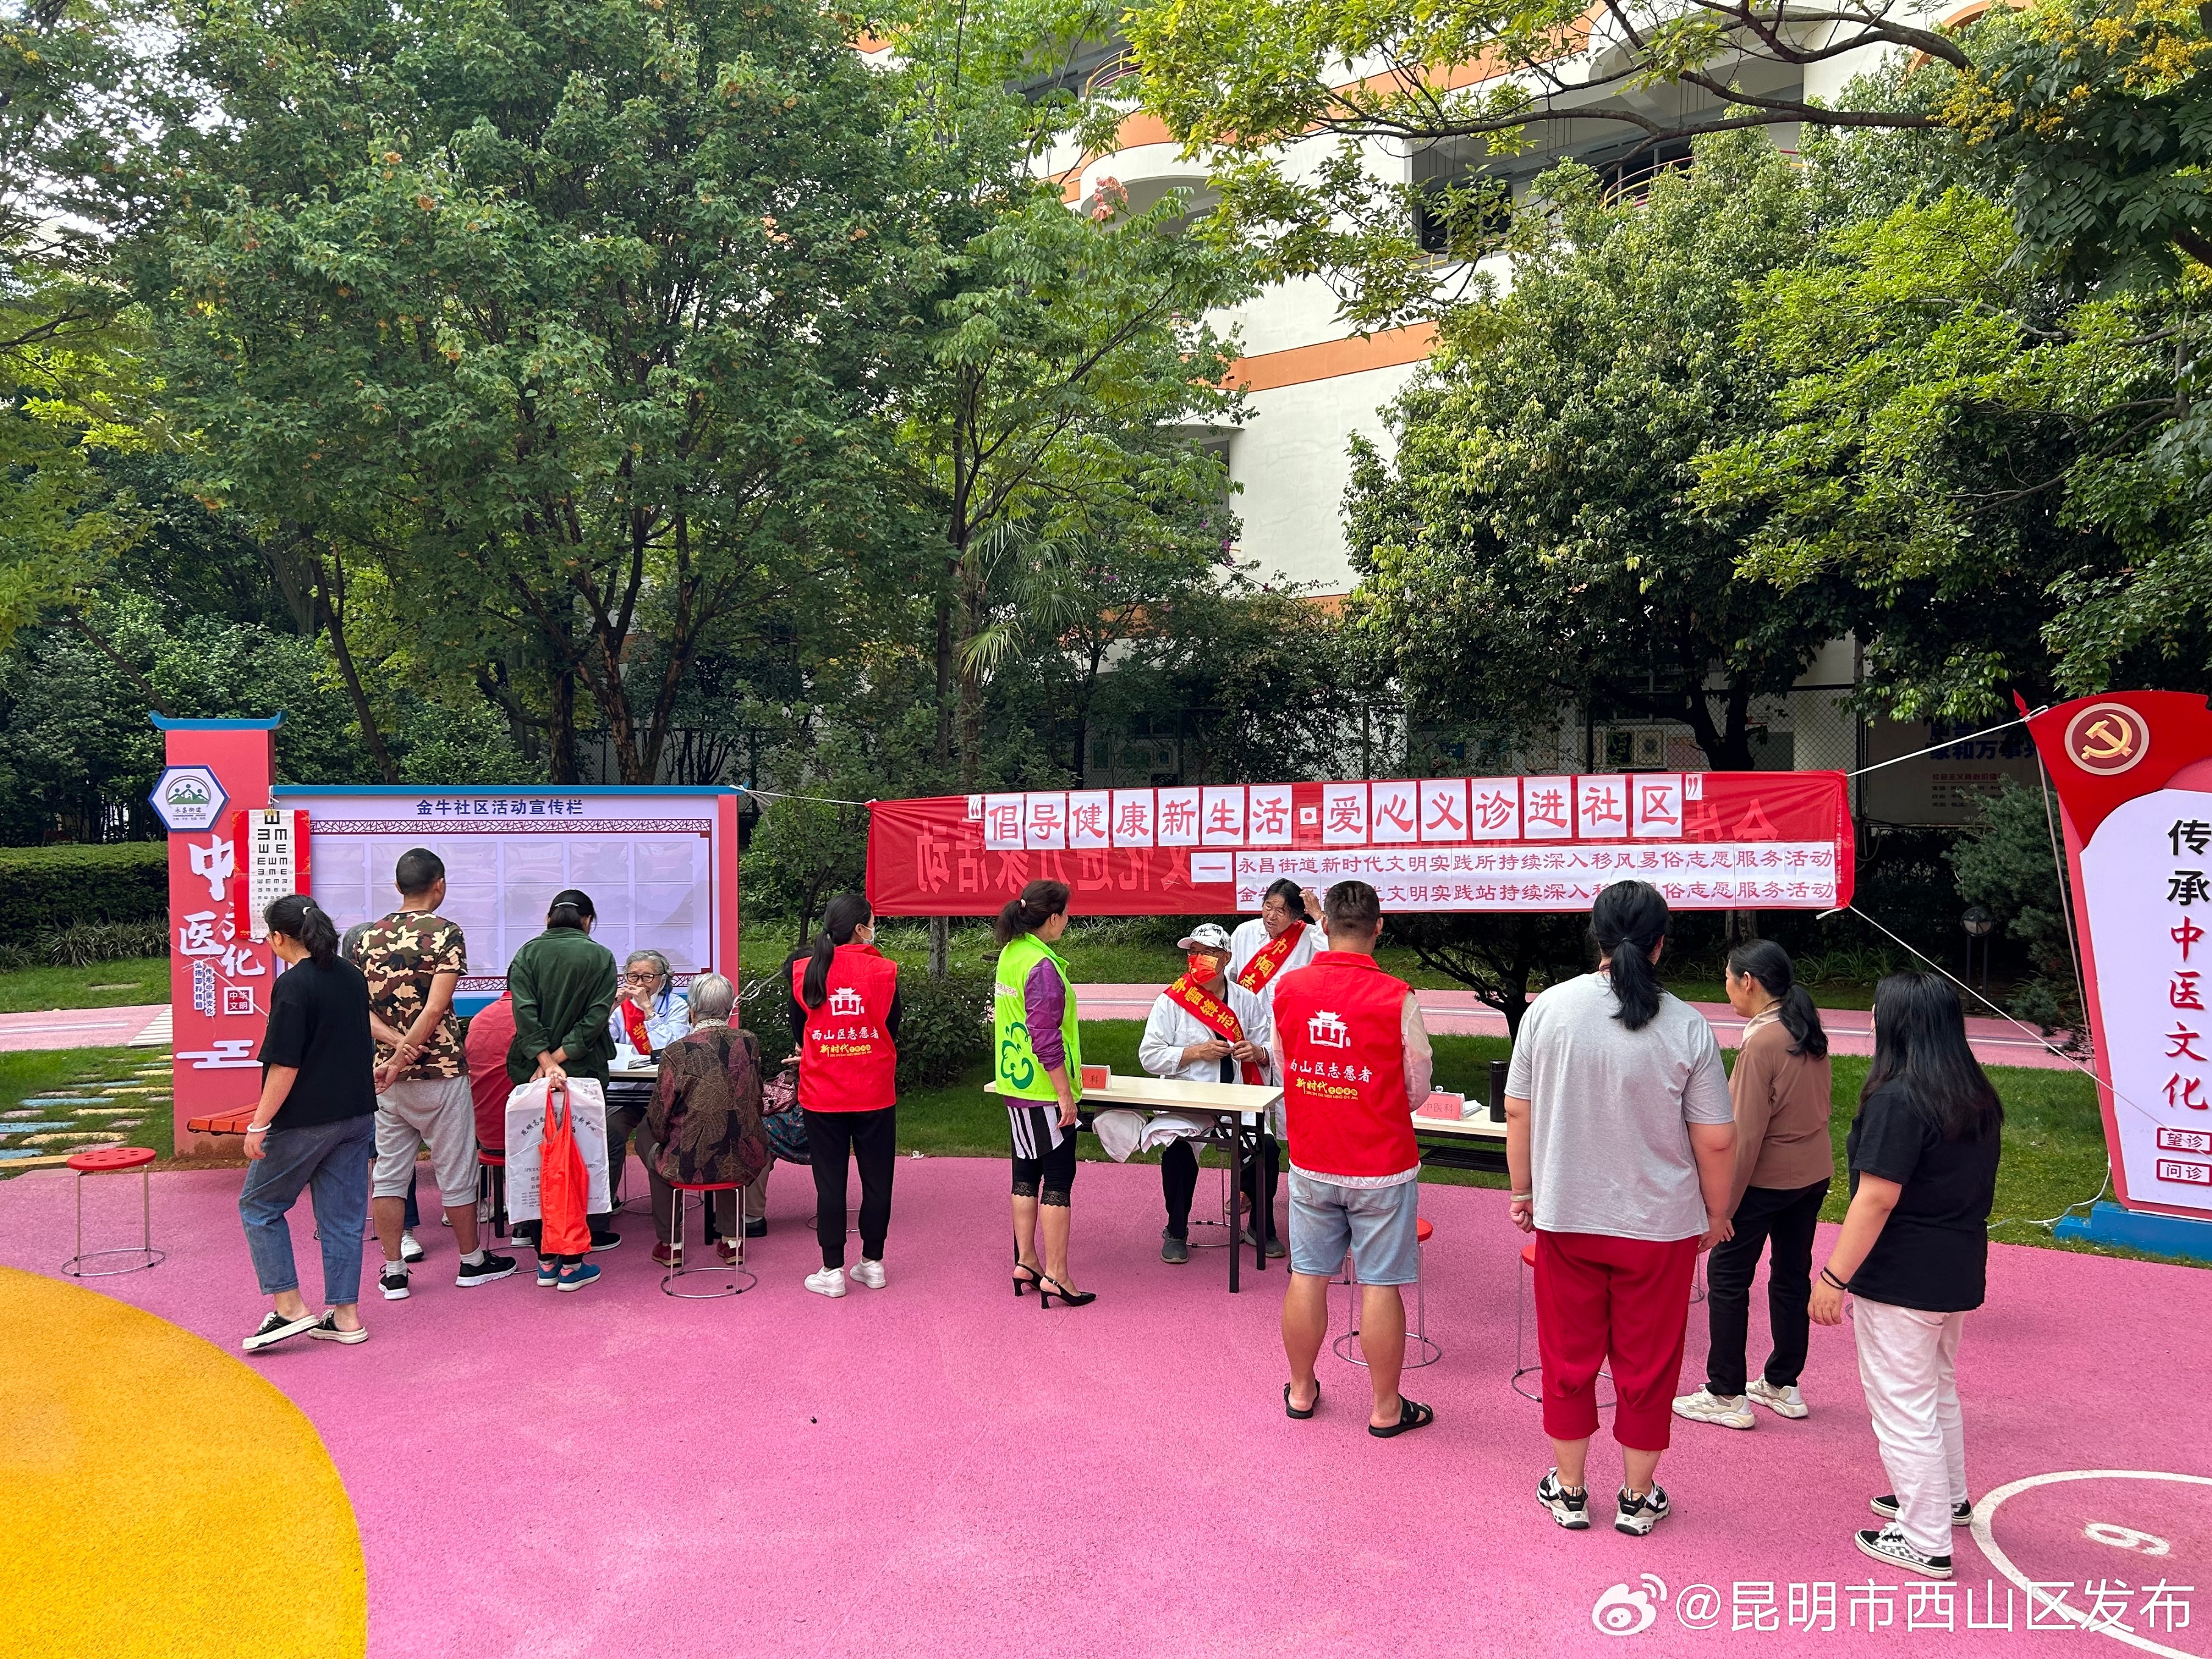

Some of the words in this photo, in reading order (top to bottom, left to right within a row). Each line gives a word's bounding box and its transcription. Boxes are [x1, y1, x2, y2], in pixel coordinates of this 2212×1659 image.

[416, 799, 583, 815] 金牛社区活动宣传栏
[179, 834, 234, 955] 中医
[2162, 819, 2212, 1111] 传承中医文化
[229, 1001, 248, 1011] 文明
[811, 1026, 880, 1041] 西山区志愿者
[1424, 1102, 1454, 1114] 中医科
[2166, 1132, 2203, 1148] 望诊
[2166, 1163, 2202, 1179] 问诊
